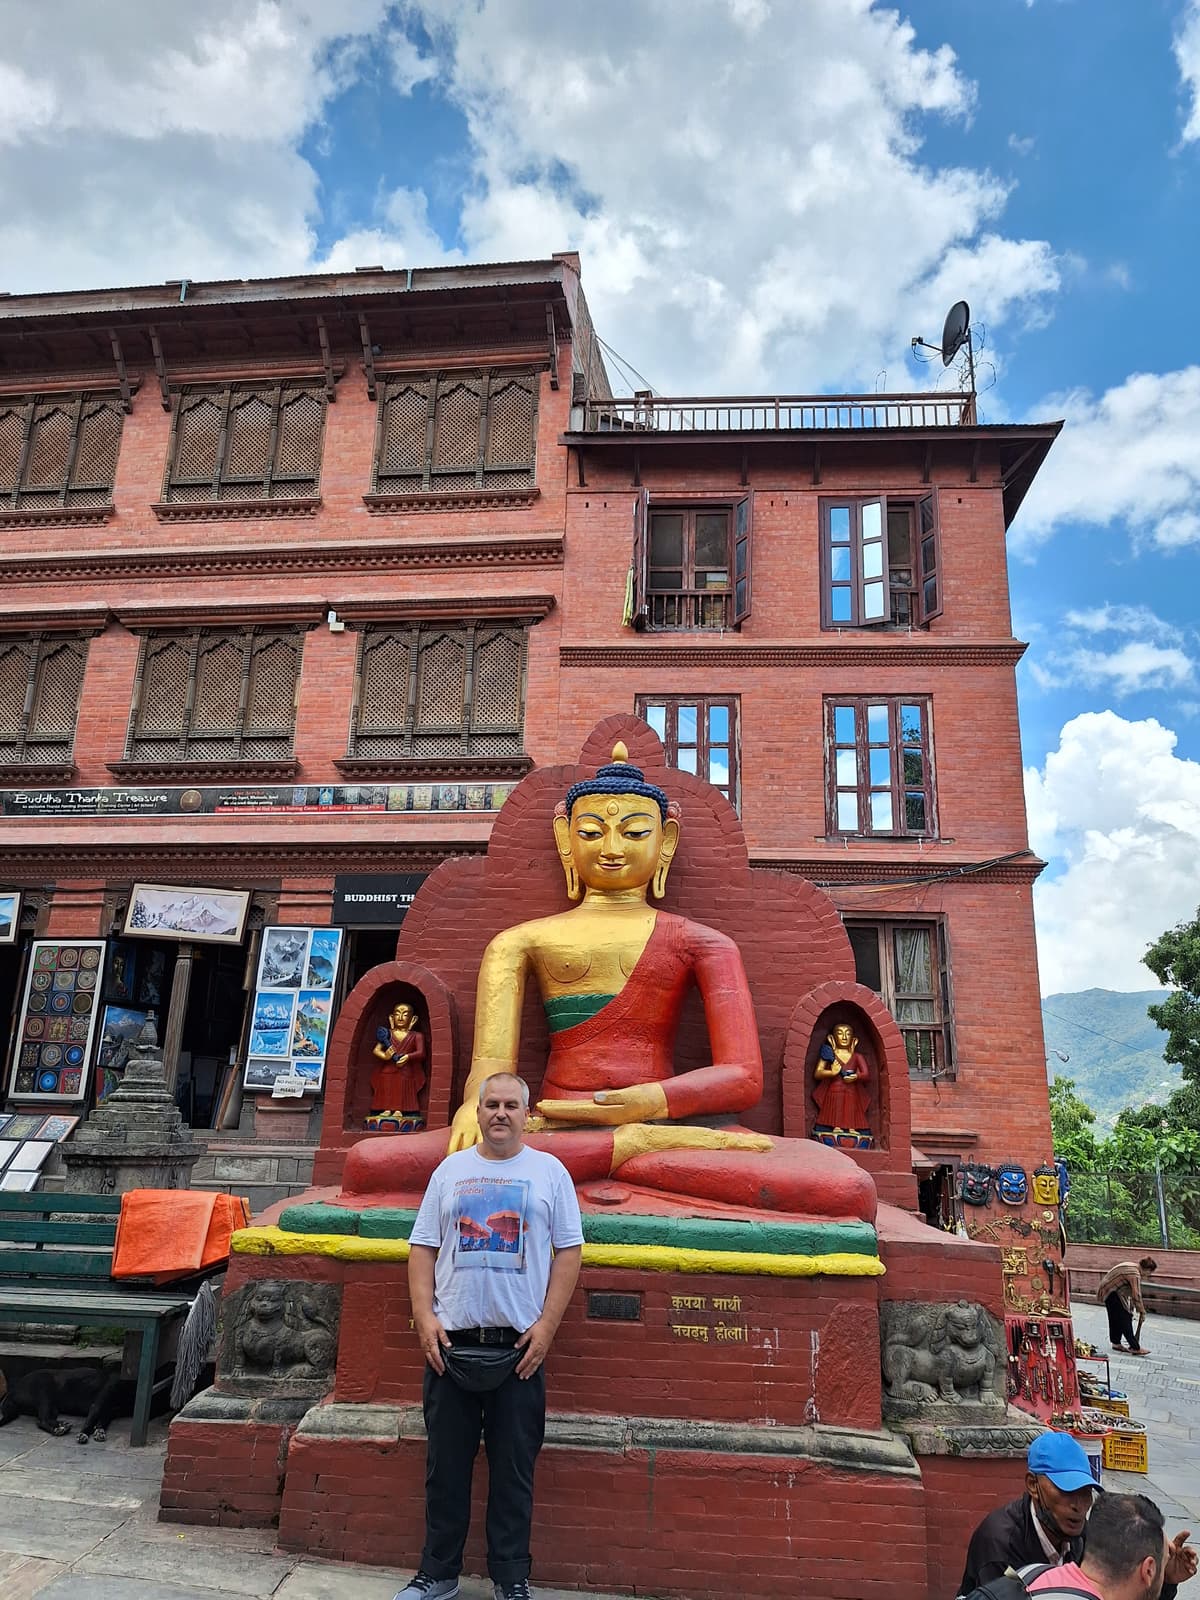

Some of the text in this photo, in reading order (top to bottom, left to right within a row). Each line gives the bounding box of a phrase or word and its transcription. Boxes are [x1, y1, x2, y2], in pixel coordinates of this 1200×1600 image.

[13, 792, 168, 804] Buddha Thanka Treasure
[344, 894, 398, 902] BUDDHIST
